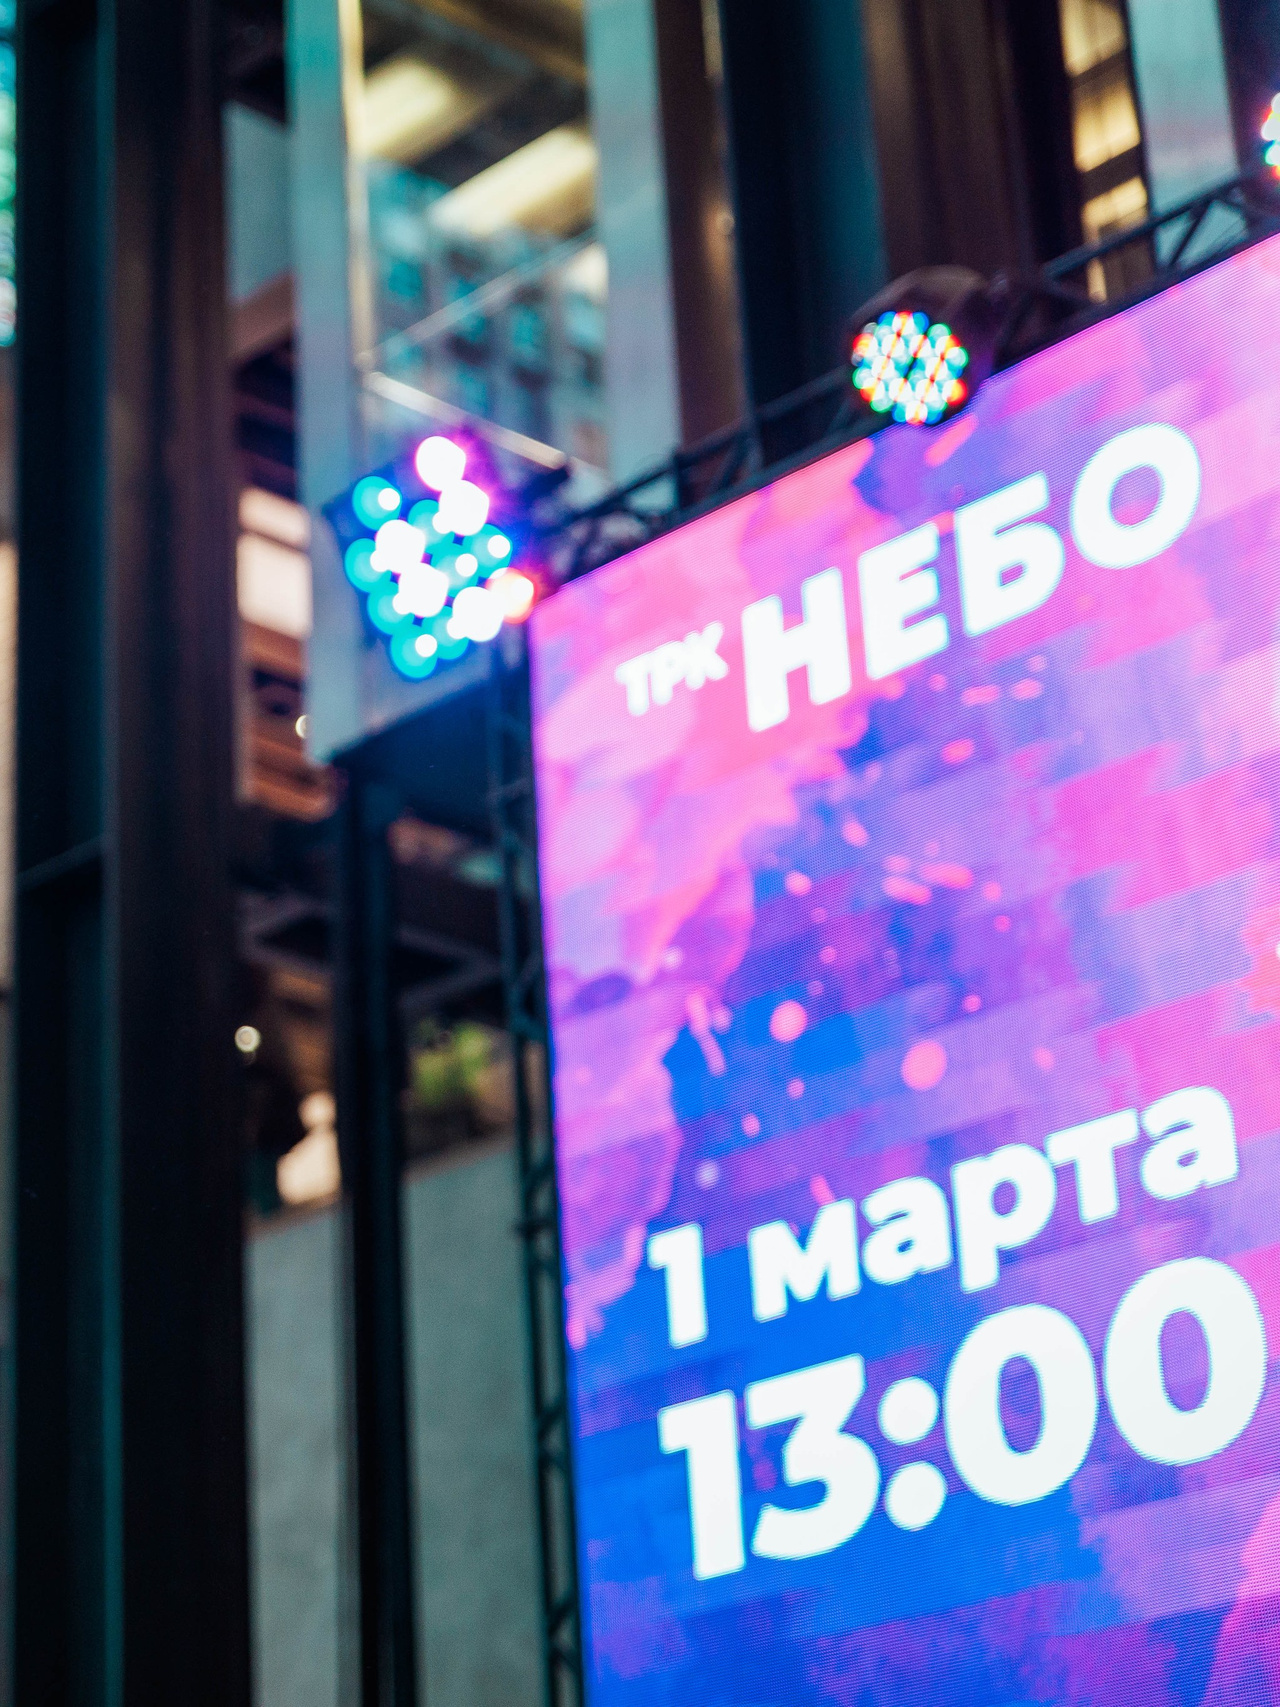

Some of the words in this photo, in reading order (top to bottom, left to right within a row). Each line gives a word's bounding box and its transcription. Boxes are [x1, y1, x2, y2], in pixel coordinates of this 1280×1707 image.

[616, 621, 728, 716] ТРК
[740, 422, 1202, 733] НЕБО
[647, 1222, 709, 1349] 1
[748, 1085, 1240, 1323] марта
[657, 1255, 1268, 1581] 13:00
